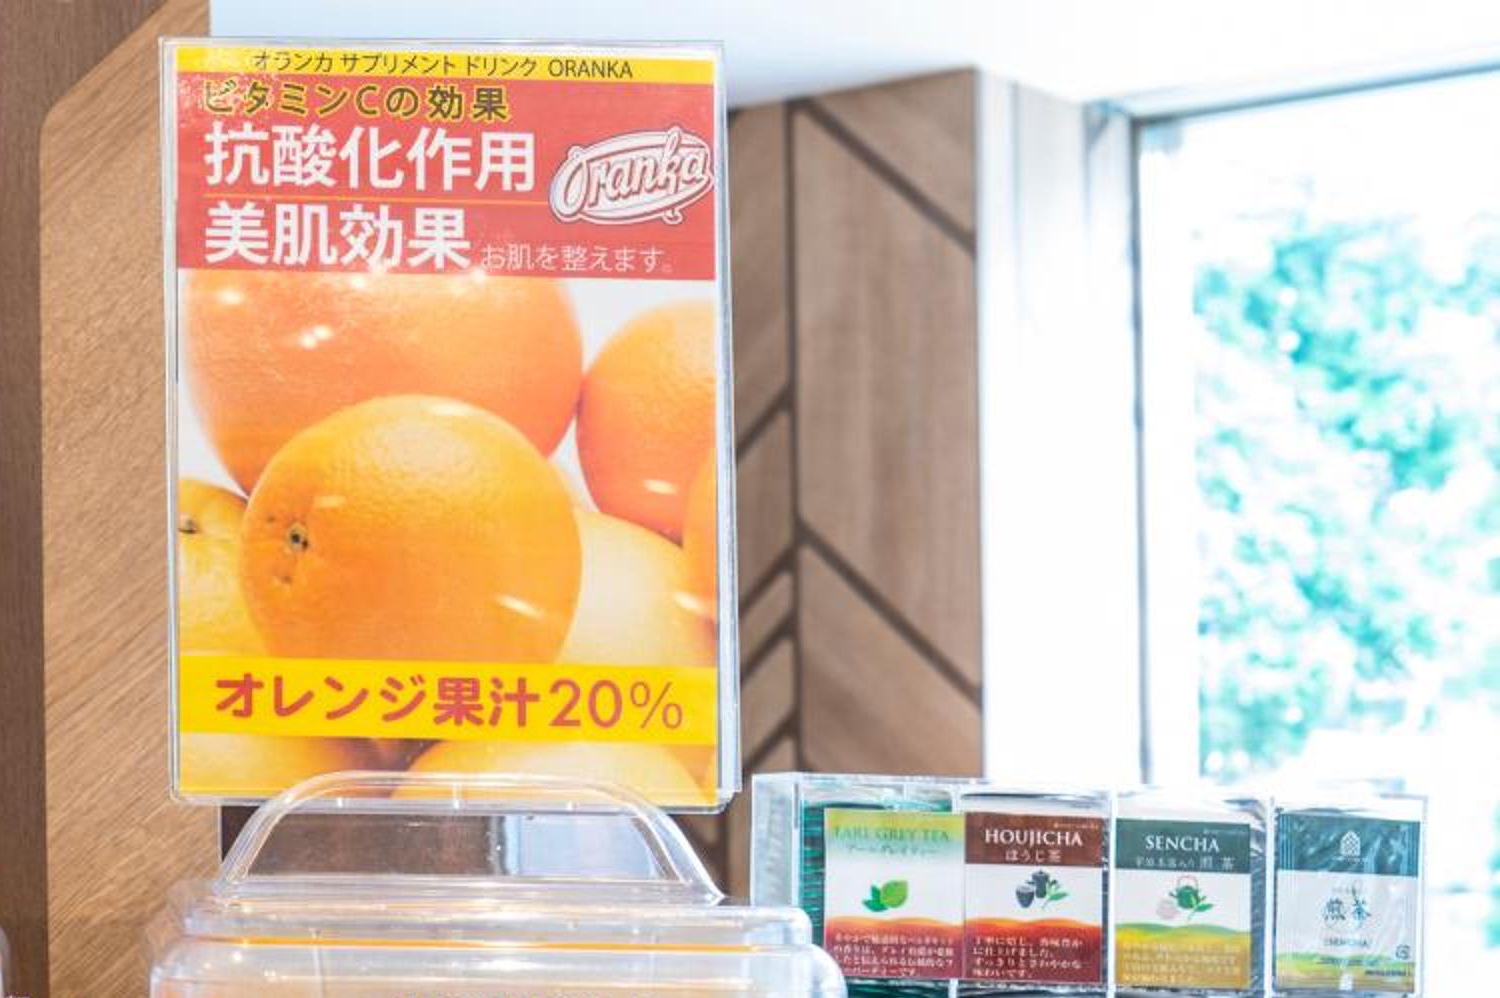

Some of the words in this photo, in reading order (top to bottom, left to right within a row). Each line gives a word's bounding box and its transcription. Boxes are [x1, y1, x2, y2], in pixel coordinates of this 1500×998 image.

[466, 55, 537, 76] ドリンク
[548, 58, 633, 79] ORANKA
[204, 78, 511, 122] ビタミンCの効果
[204, 121, 535, 192] 抗酸化作用
[550, 128, 713, 224] Oranka
[204, 201, 472, 270] 美肌効果
[215, 672, 684, 730] オレンジ果汁20%
[984, 828, 1084, 848] HOUJICHA
[1004, 848, 1062, 864] ほうじ茶
[1144, 834, 1221, 854] SENCHA
